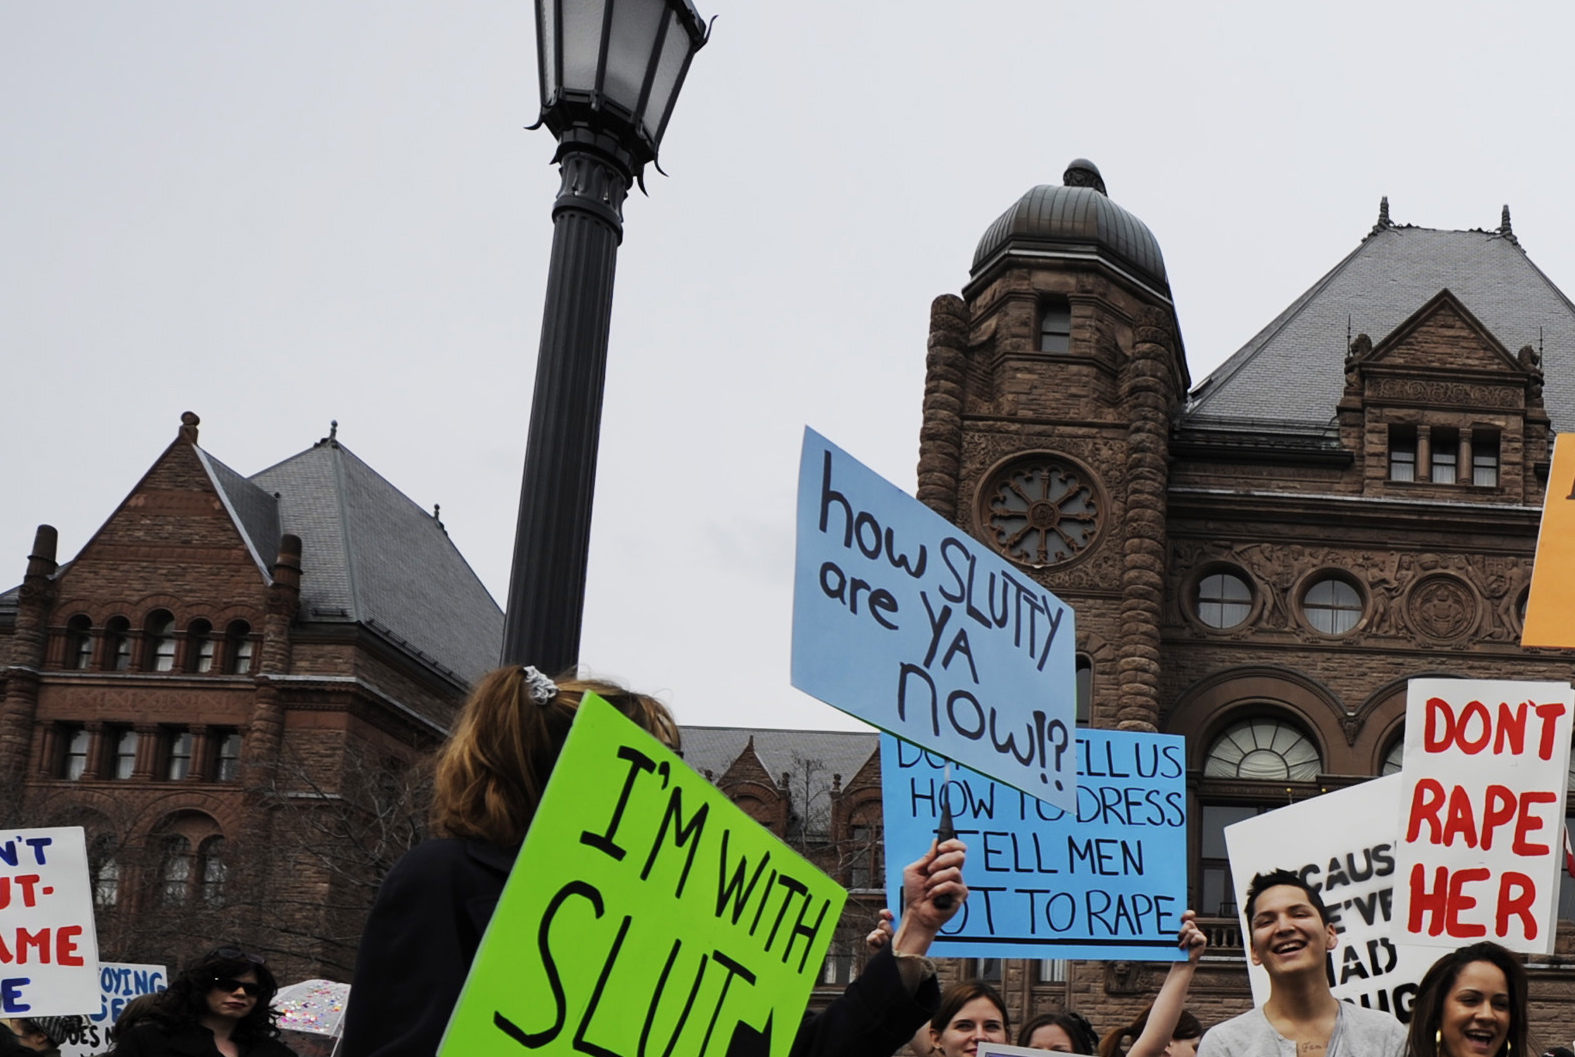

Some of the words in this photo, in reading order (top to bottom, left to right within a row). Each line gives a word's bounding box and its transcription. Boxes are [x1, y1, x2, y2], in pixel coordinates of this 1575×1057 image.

[818, 449, 927, 579] how
[938, 536, 1064, 672] SLUTTY
[818, 560, 900, 631] are
[919, 591, 980, 685] YA
[1424, 697, 1567, 761] DON'T
[1075, 738, 1131, 778] LL
[1134, 741, 1184, 779] US
[910, 776, 996, 820] HOW
[1076, 785, 1186, 828] DRESS
[1405, 778, 1557, 857] RAPE
[579, 744, 710, 900] I'M
[714, 828, 832, 975] WITH
[1067, 834, 1145, 877] MEN
[1287, 842, 1397, 894] CAUS
[1014, 888, 1077, 935] TO
[1085, 889, 1182, 937] RAPE
[1407, 863, 1538, 941] HER
[101, 966, 168, 997] OYING
[68, 1024, 101, 1049] OES
